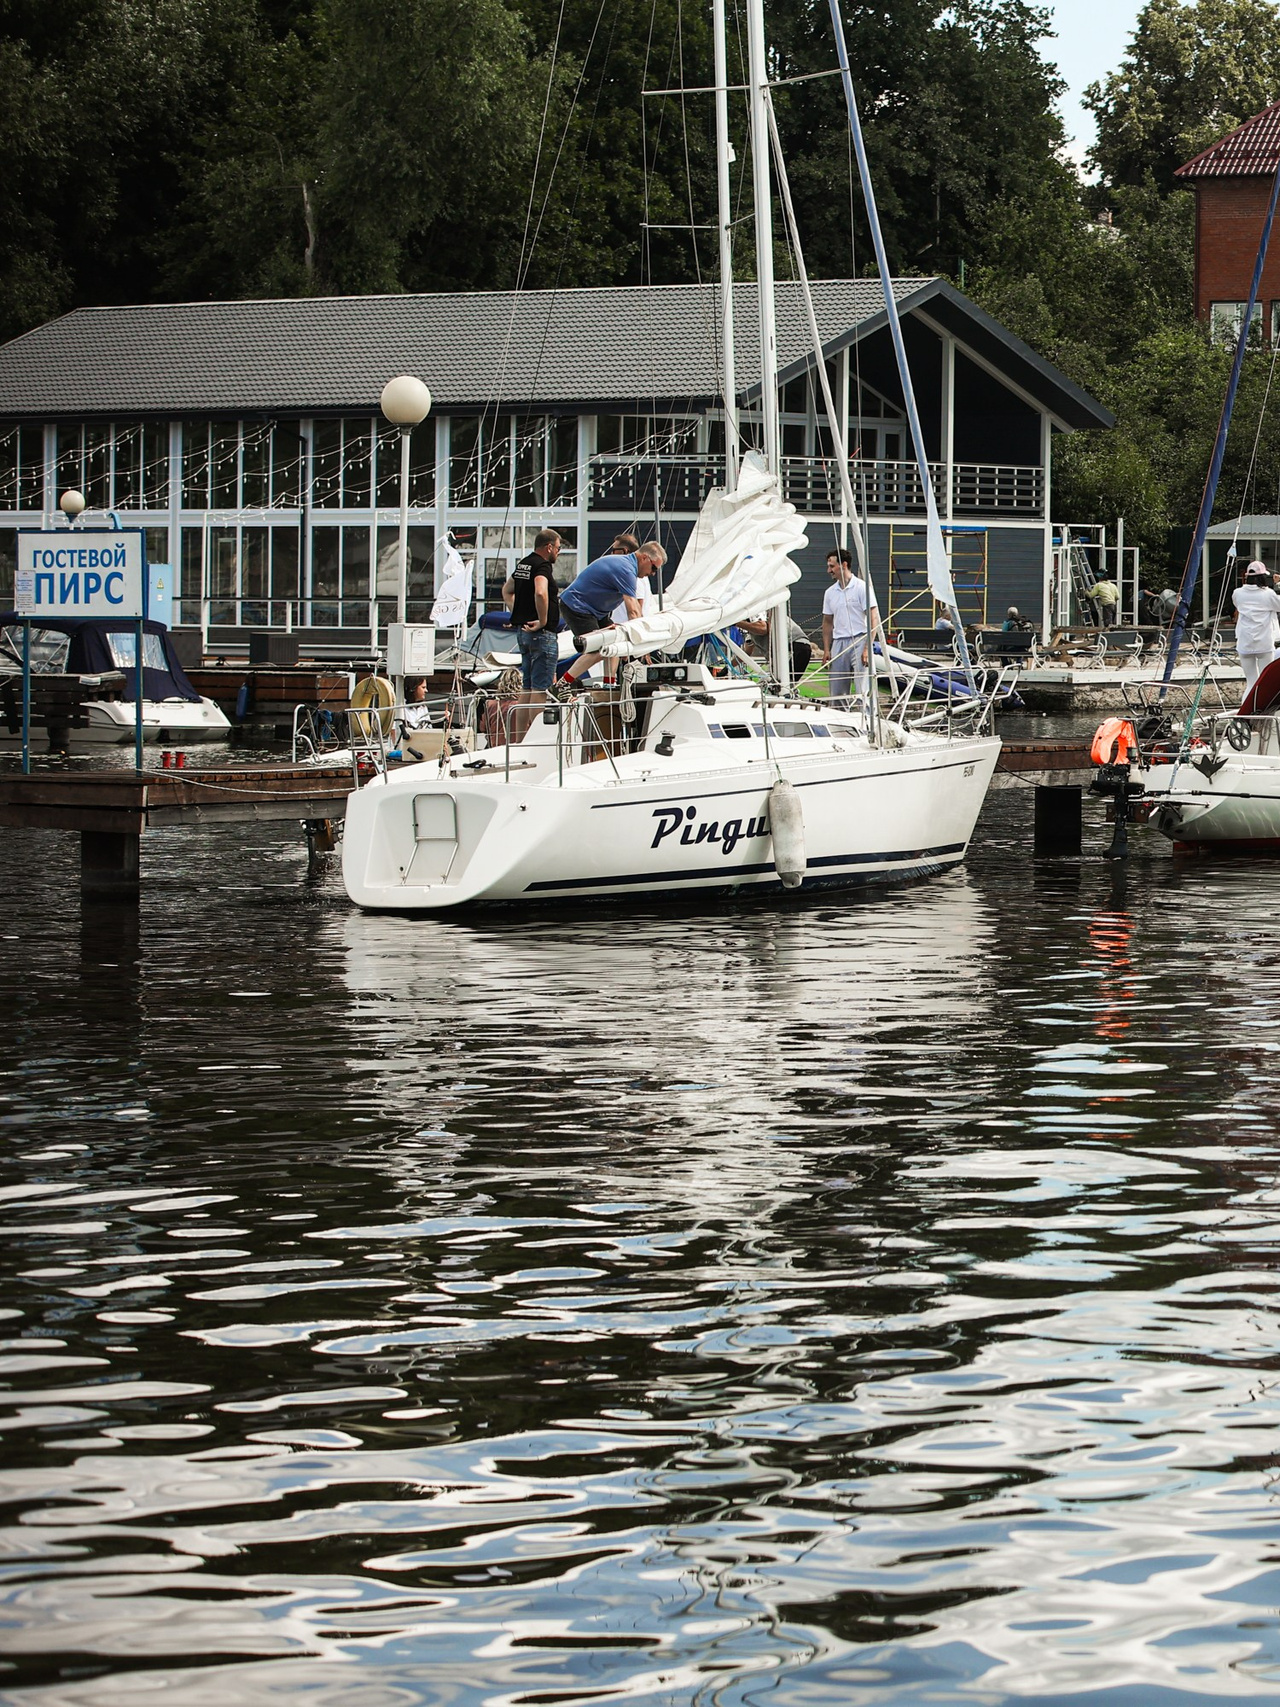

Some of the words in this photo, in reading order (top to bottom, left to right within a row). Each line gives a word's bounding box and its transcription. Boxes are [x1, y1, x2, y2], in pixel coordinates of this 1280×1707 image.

[33, 543, 126, 568] ГОСТЕВОЙ
[35, 571, 124, 605] ПИРС
[650, 805, 773, 856] Pingu
